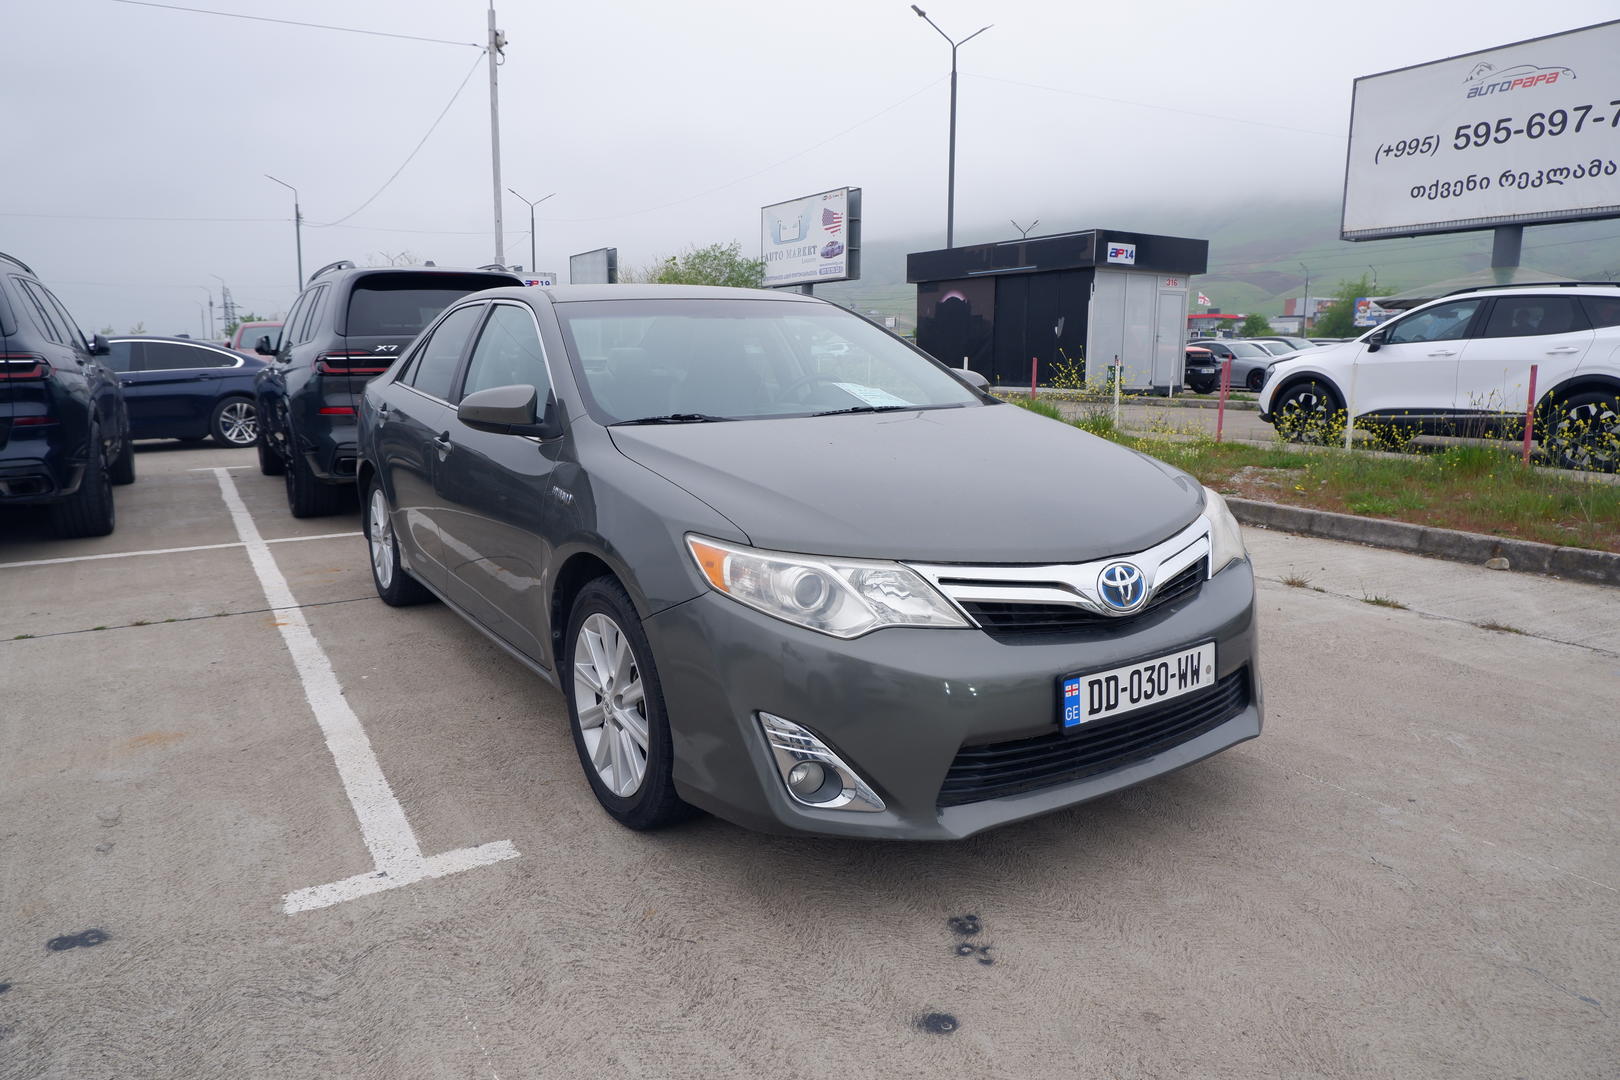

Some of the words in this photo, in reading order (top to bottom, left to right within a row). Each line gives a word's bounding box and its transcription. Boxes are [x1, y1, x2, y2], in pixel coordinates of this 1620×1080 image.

[1374, 134, 1441, 165] (+995)
[1410, 173, 1491, 201] თქვენი
[1498, 158, 1618, 190] რეკლამა
[765, 250, 784, 262] AUTO
[375, 344, 399, 352] X7
[1088, 651, 1201, 716] DD-030-WW
[1065, 705, 1079, 721] GE
